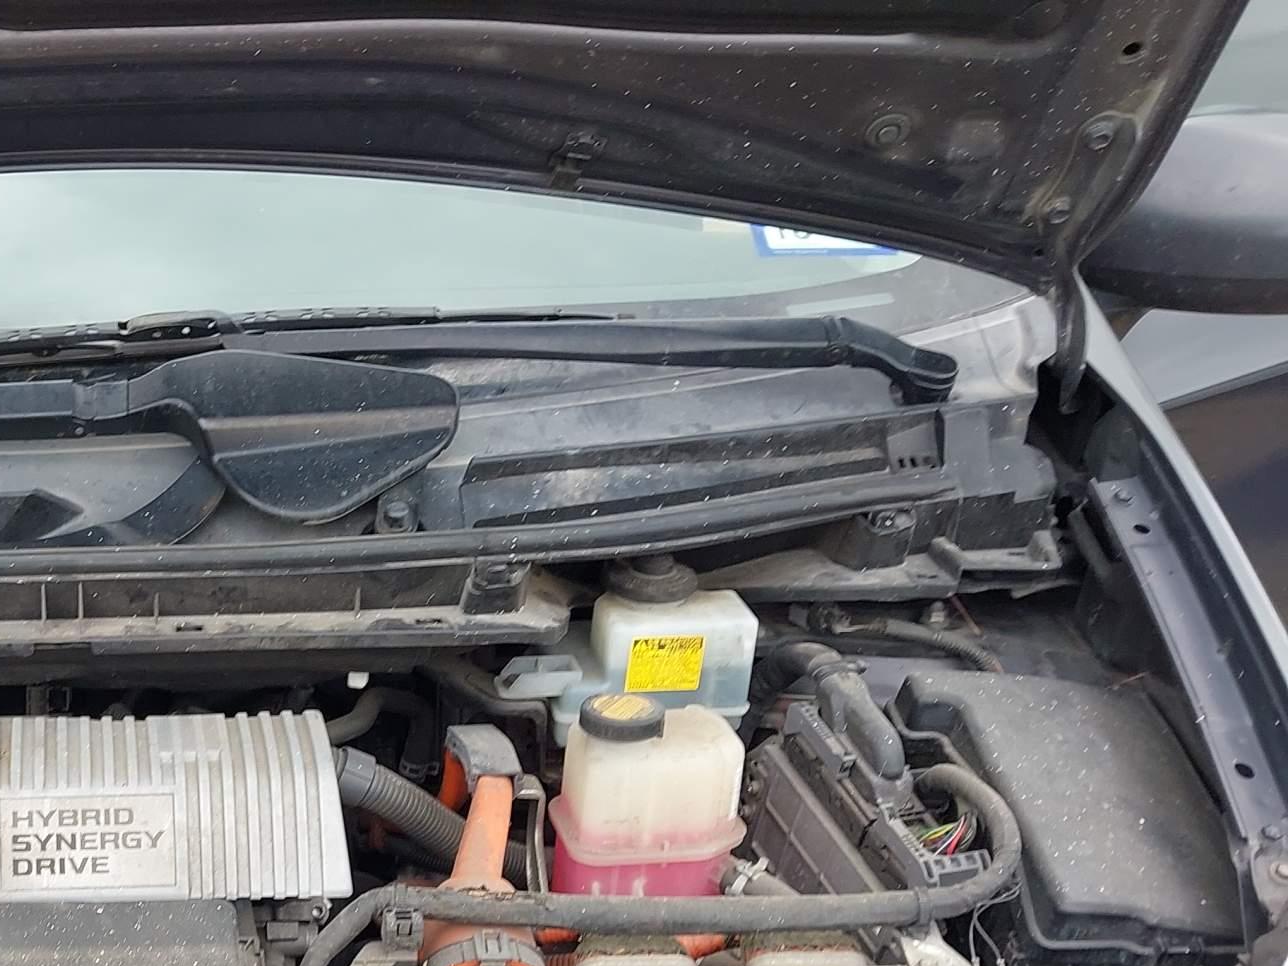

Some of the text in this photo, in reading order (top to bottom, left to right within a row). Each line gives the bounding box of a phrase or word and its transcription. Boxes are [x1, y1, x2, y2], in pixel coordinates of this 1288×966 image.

[11, 807, 135, 828] HYBRID
[11, 830, 166, 852] SYNERGY
[11, 856, 110, 877] DRIVE
